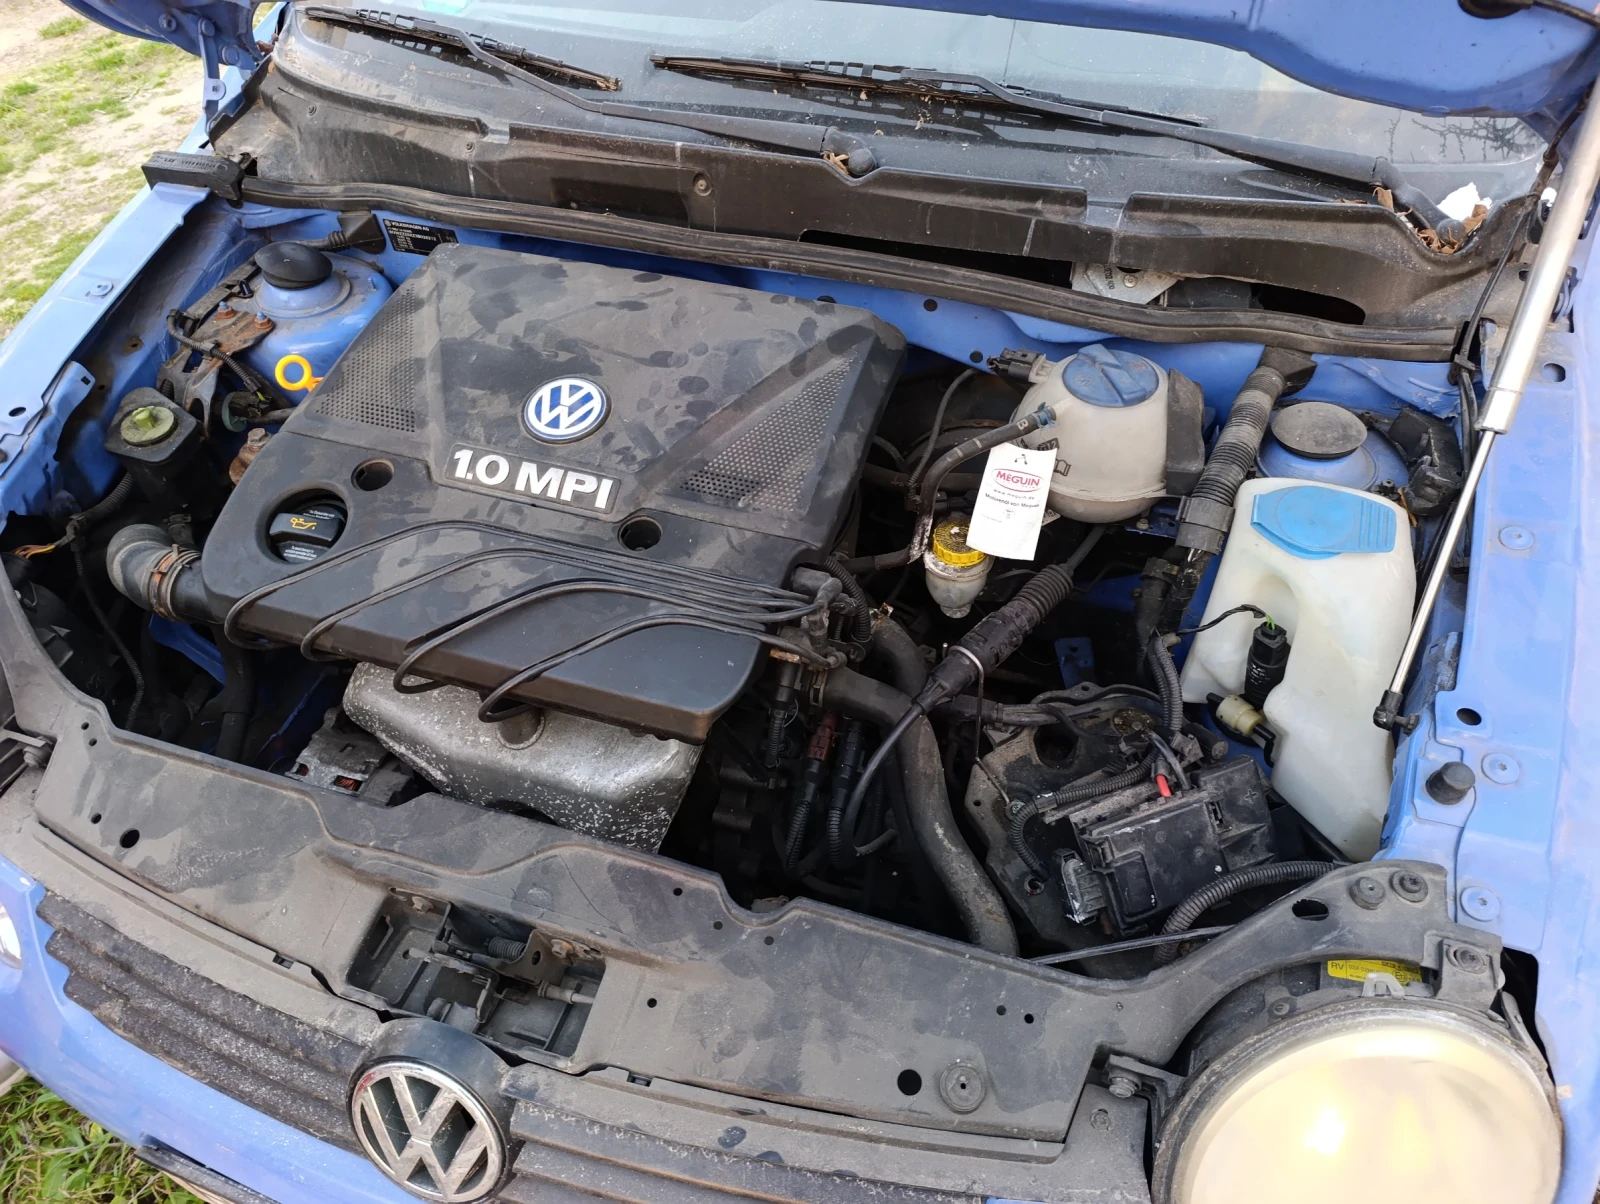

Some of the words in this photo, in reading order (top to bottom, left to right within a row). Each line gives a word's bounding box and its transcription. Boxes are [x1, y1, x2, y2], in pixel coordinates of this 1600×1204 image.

[391, 221, 422, 230] VOLKSWAGEN
[453, 449, 510, 485] 1.0
[514, 461, 613, 509] MPI
[1330, 961, 1345, 971] RV
